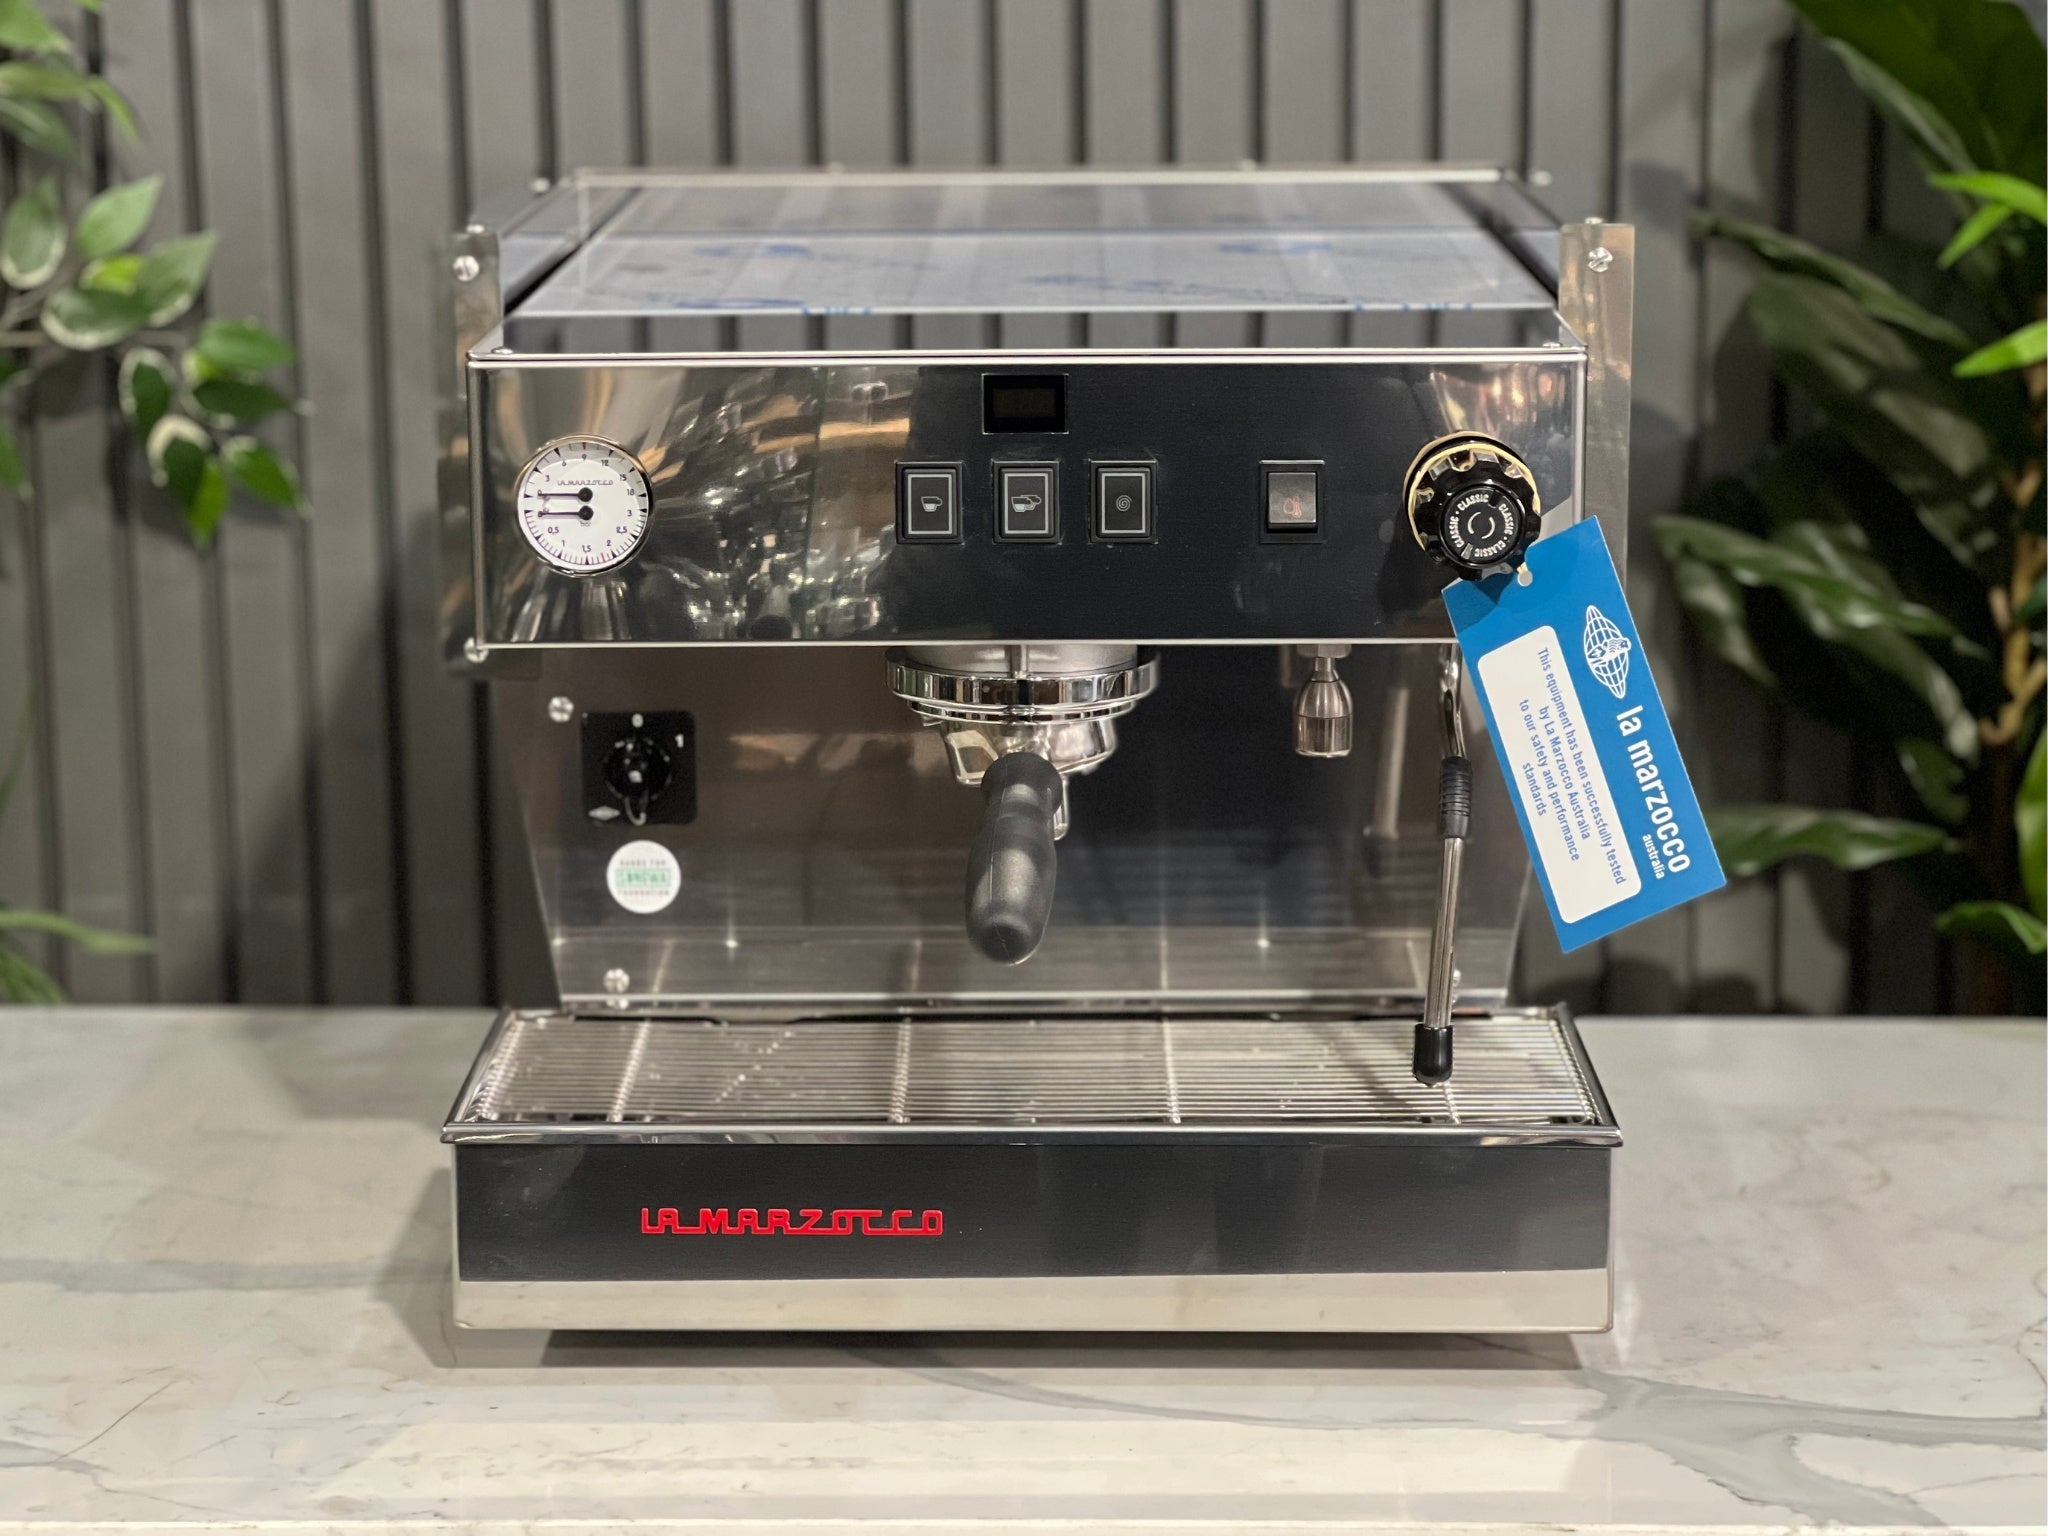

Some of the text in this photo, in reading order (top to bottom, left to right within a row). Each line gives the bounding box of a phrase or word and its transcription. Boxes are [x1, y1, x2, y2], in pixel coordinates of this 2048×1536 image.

[1457, 493, 1489, 511] CLASSIC
[1499, 504, 1514, 535] CLASSIC
[1449, 516, 1465, 548] CLASSIC
[1474, 540, 1506, 558] CLASSIC
[1520, 700, 1580, 861] to our safety and performance
[1538, 648, 1627, 885] This equipment has been successfully tested
[1539, 706, 1591, 841] by La Marzocco Australia
[1616, 705, 1691, 873] la marzocco
[1523, 763, 1547, 817] standards
[1642, 834, 1665, 880] australia
[642, 1208, 679, 1235] LA
